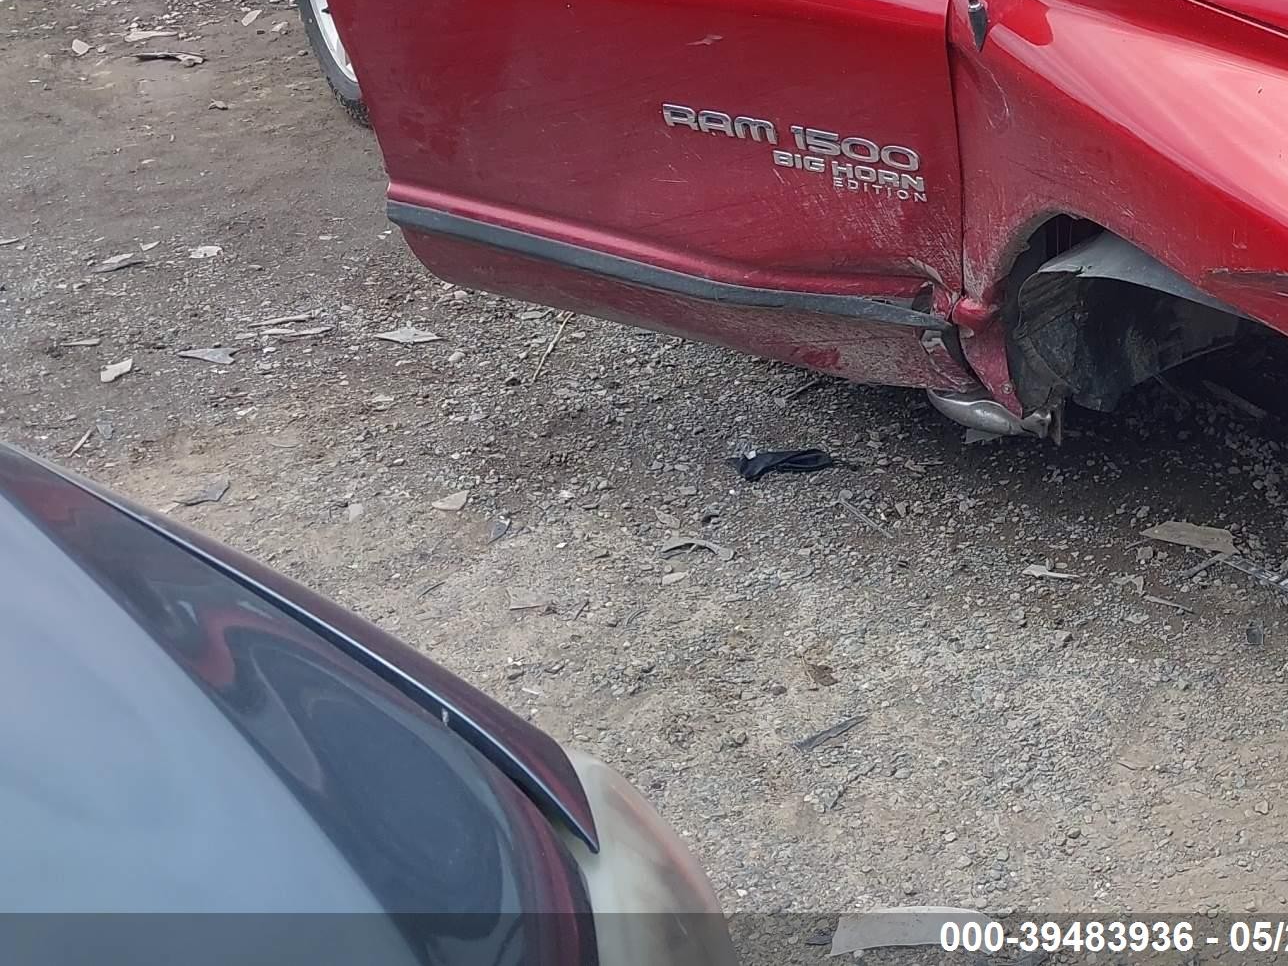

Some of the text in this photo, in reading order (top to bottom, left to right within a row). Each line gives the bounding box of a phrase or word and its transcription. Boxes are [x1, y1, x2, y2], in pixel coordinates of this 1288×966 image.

[662, 103, 921, 172] RAM 1500
[772, 149, 926, 192] BIG HORN
[833, 176, 928, 203] EDITION
